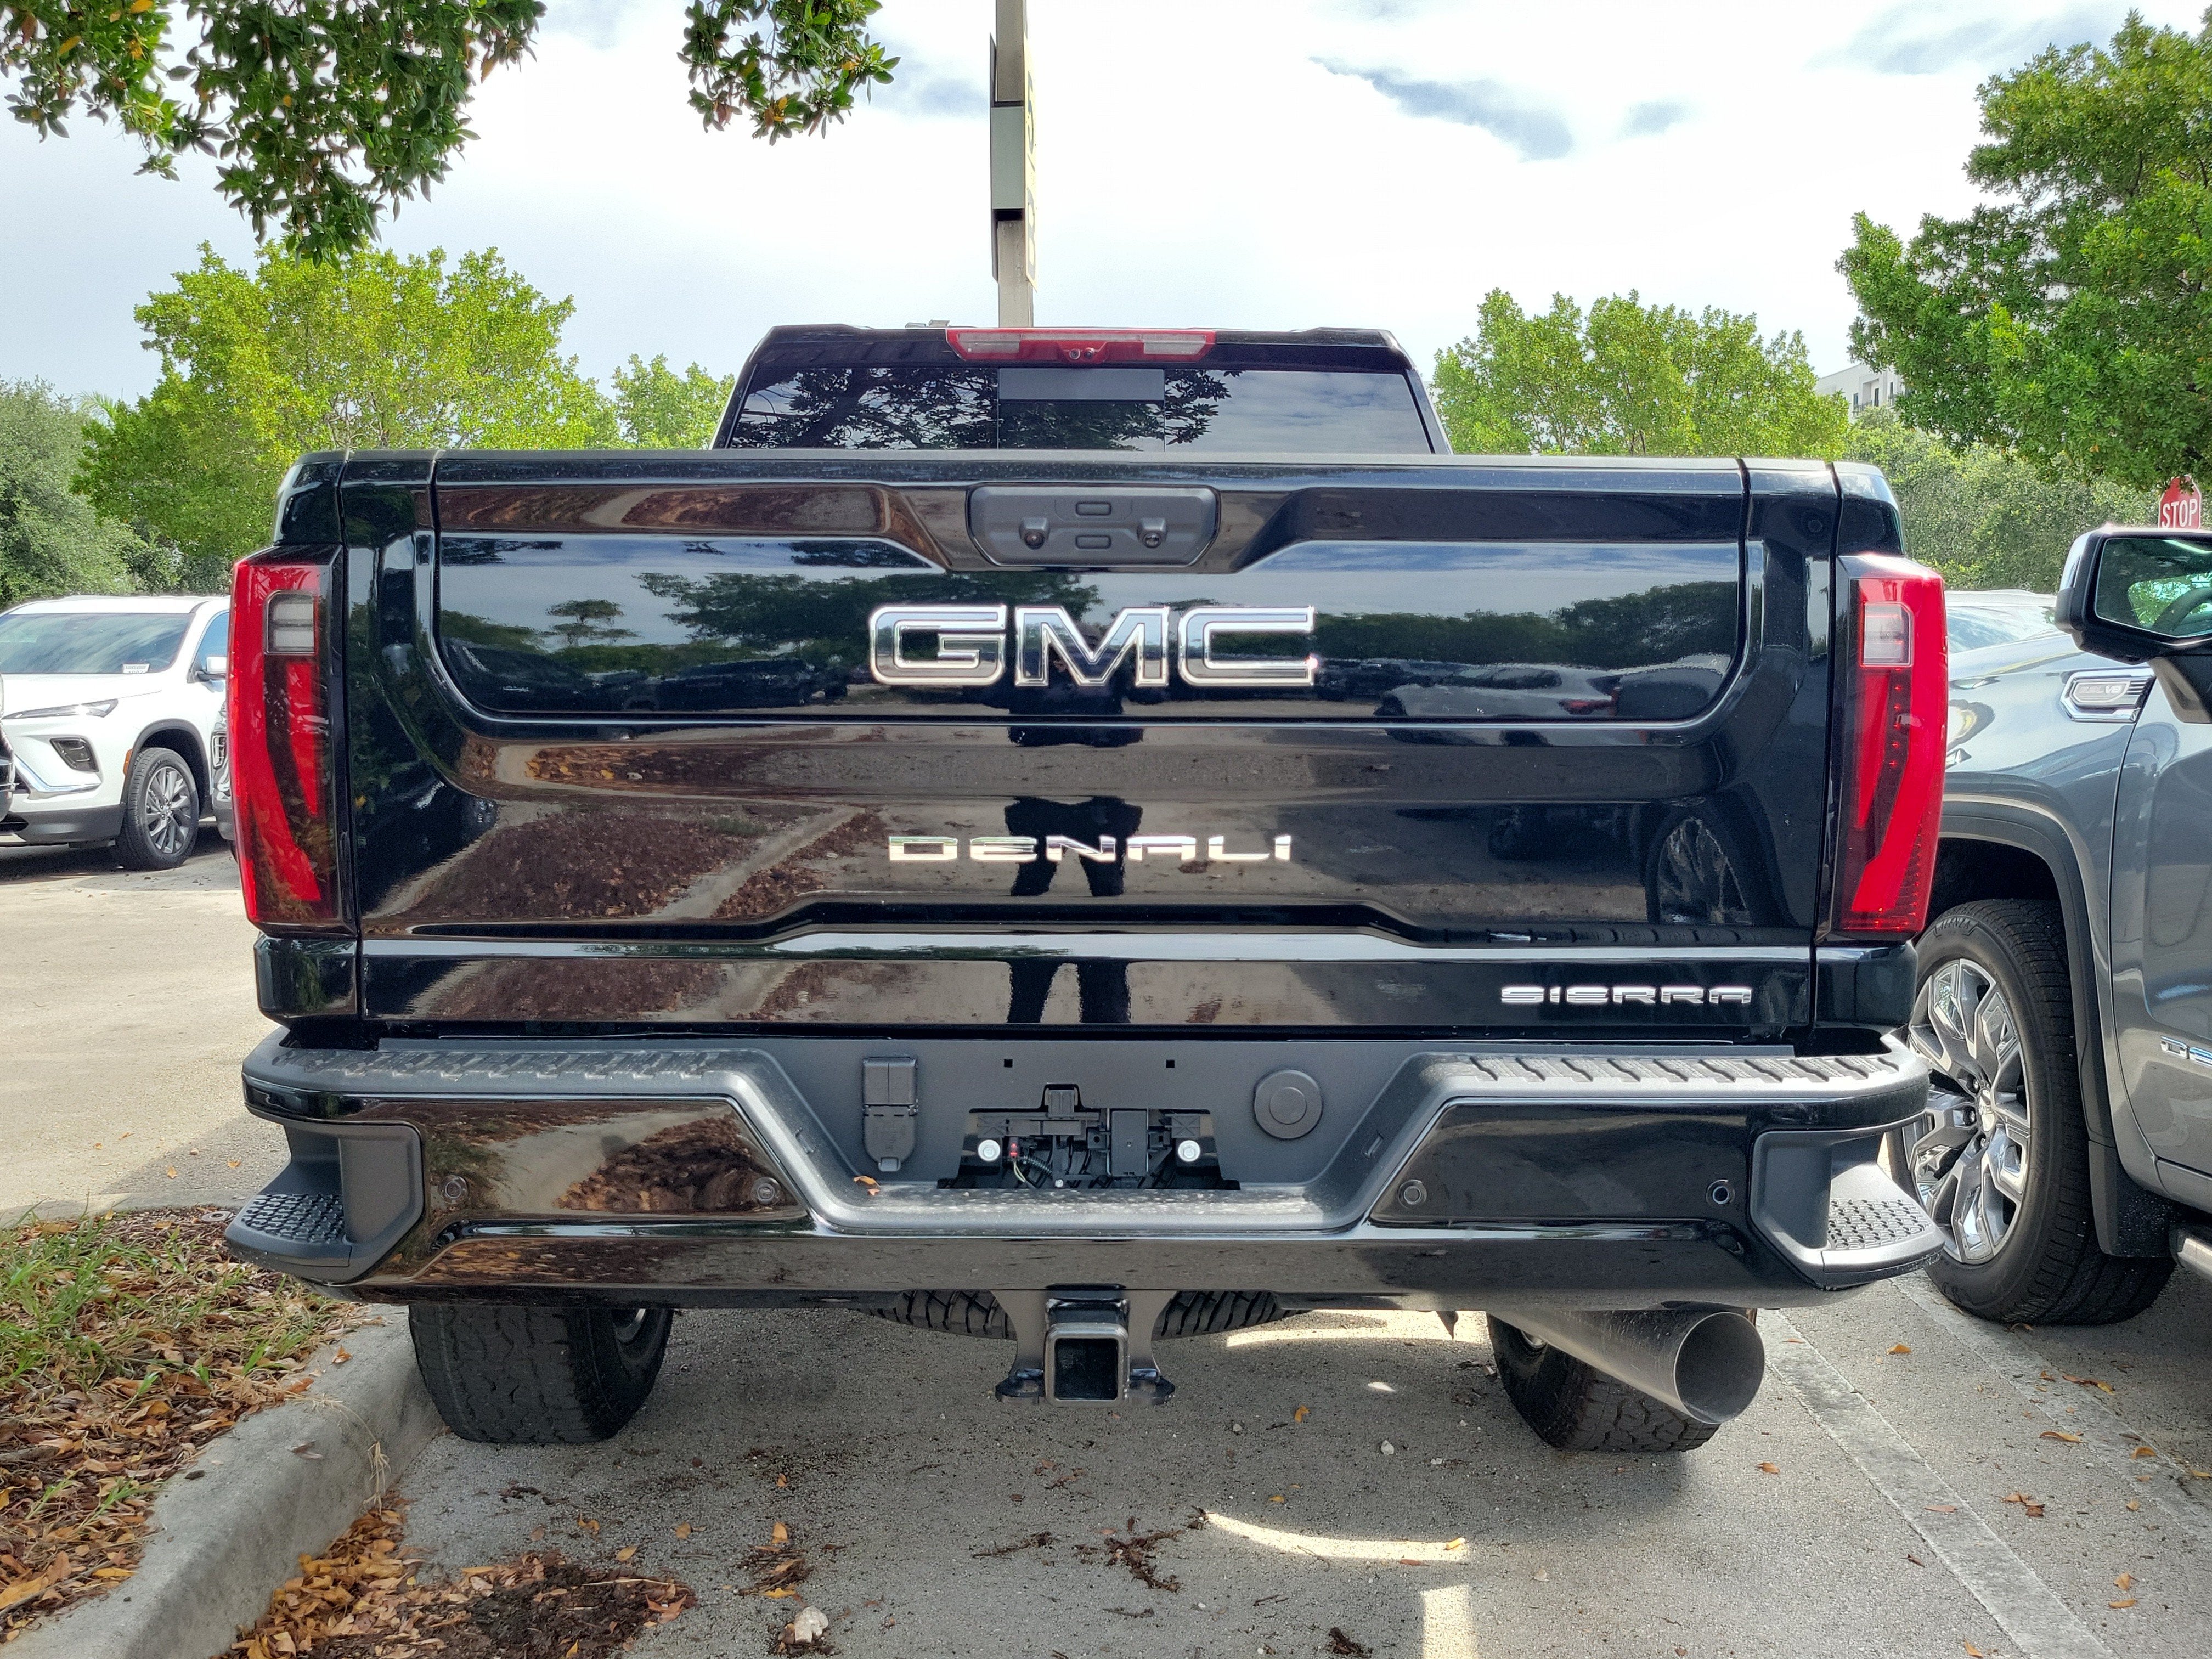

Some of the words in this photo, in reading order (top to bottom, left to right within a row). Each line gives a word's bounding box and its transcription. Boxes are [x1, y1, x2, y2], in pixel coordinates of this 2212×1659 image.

[2162, 499, 2198, 528] STOP
[868, 605, 1316, 687] GMC
[888, 836, 1291, 861] DENALI
[1939, 917, 1971, 930] ALENZA
[1500, 987, 1752, 1004] SIERRA
